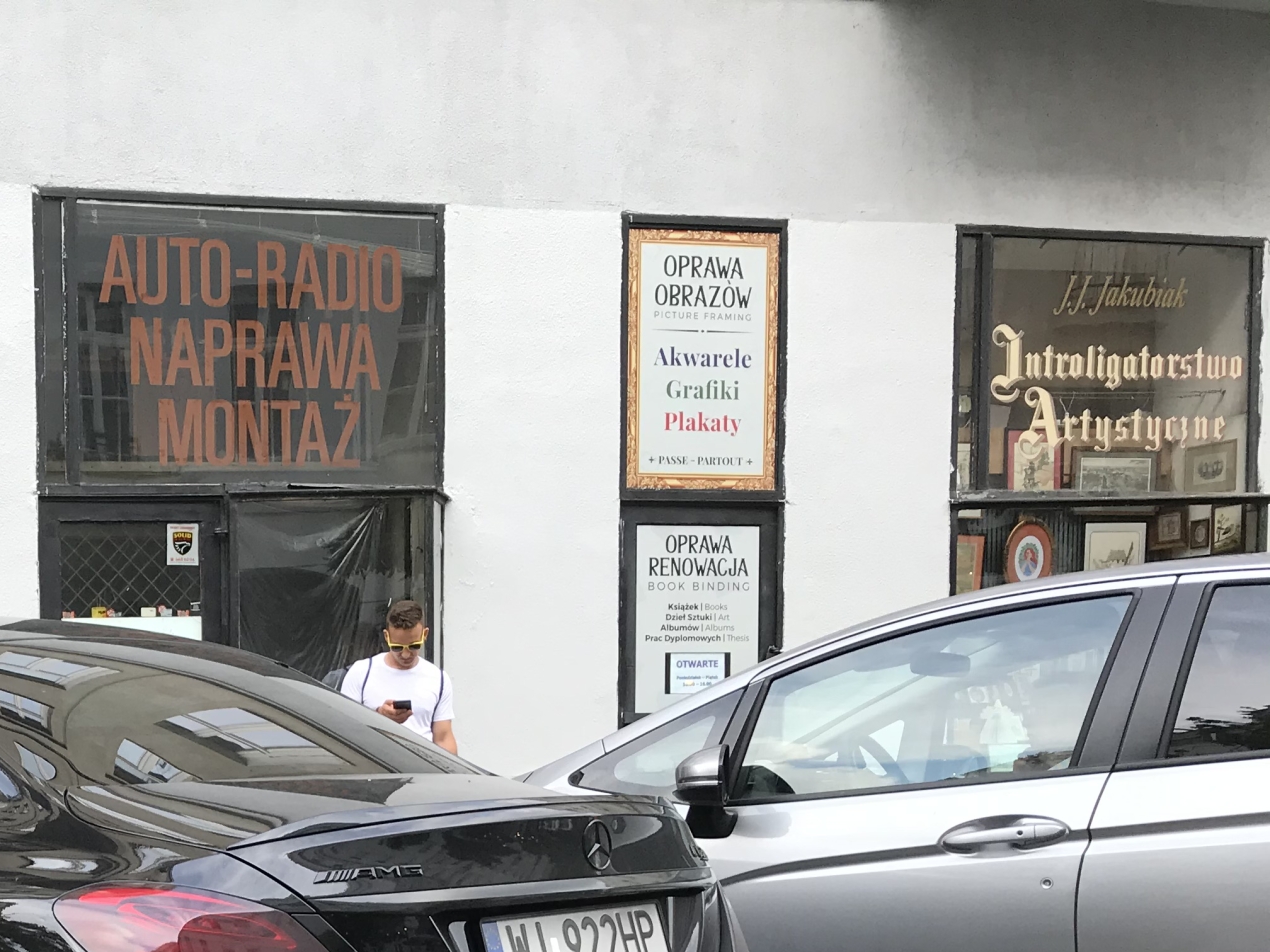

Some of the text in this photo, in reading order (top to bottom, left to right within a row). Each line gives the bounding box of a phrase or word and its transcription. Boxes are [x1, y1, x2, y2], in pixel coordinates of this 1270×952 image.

[99, 235, 402, 313] AUTO-RADIO
[663, 255, 744, 279] OPRAWA
[654, 281, 753, 309] OBRAZÓW
[1088, 275, 1188, 316] Jakubiak
[653, 311, 752, 321] PICTURE FRAMING
[130, 317, 381, 390] NAPRAWA
[653, 347, 752, 369] Akwarele
[990, 323, 1243, 403] Introligatorstwo
[666, 379, 740, 400] Grafiki
[158, 393, 361, 468] MONTAŻ
[664, 412, 742, 437] Plakaty
[1019, 386, 1227, 460] Artystyczne
[658, 455, 689, 465] PASSE
[697, 456, 744, 466] PARTOUT
[665, 534, 733, 554] OPRAWA
[648, 557, 749, 577] RENOWACJA
[647, 582, 750, 591] BOOK BINDING
[665, 613, 730, 621] Dzieł Sztuki Art
[668, 603, 728, 612] Książek Books
[660, 623, 735, 632] Albumów Albums
[645, 634, 750, 643] Prac Dyplomowych Thesis
[676, 660, 719, 668] OTWARTE
[348, 865, 424, 881] AMG
